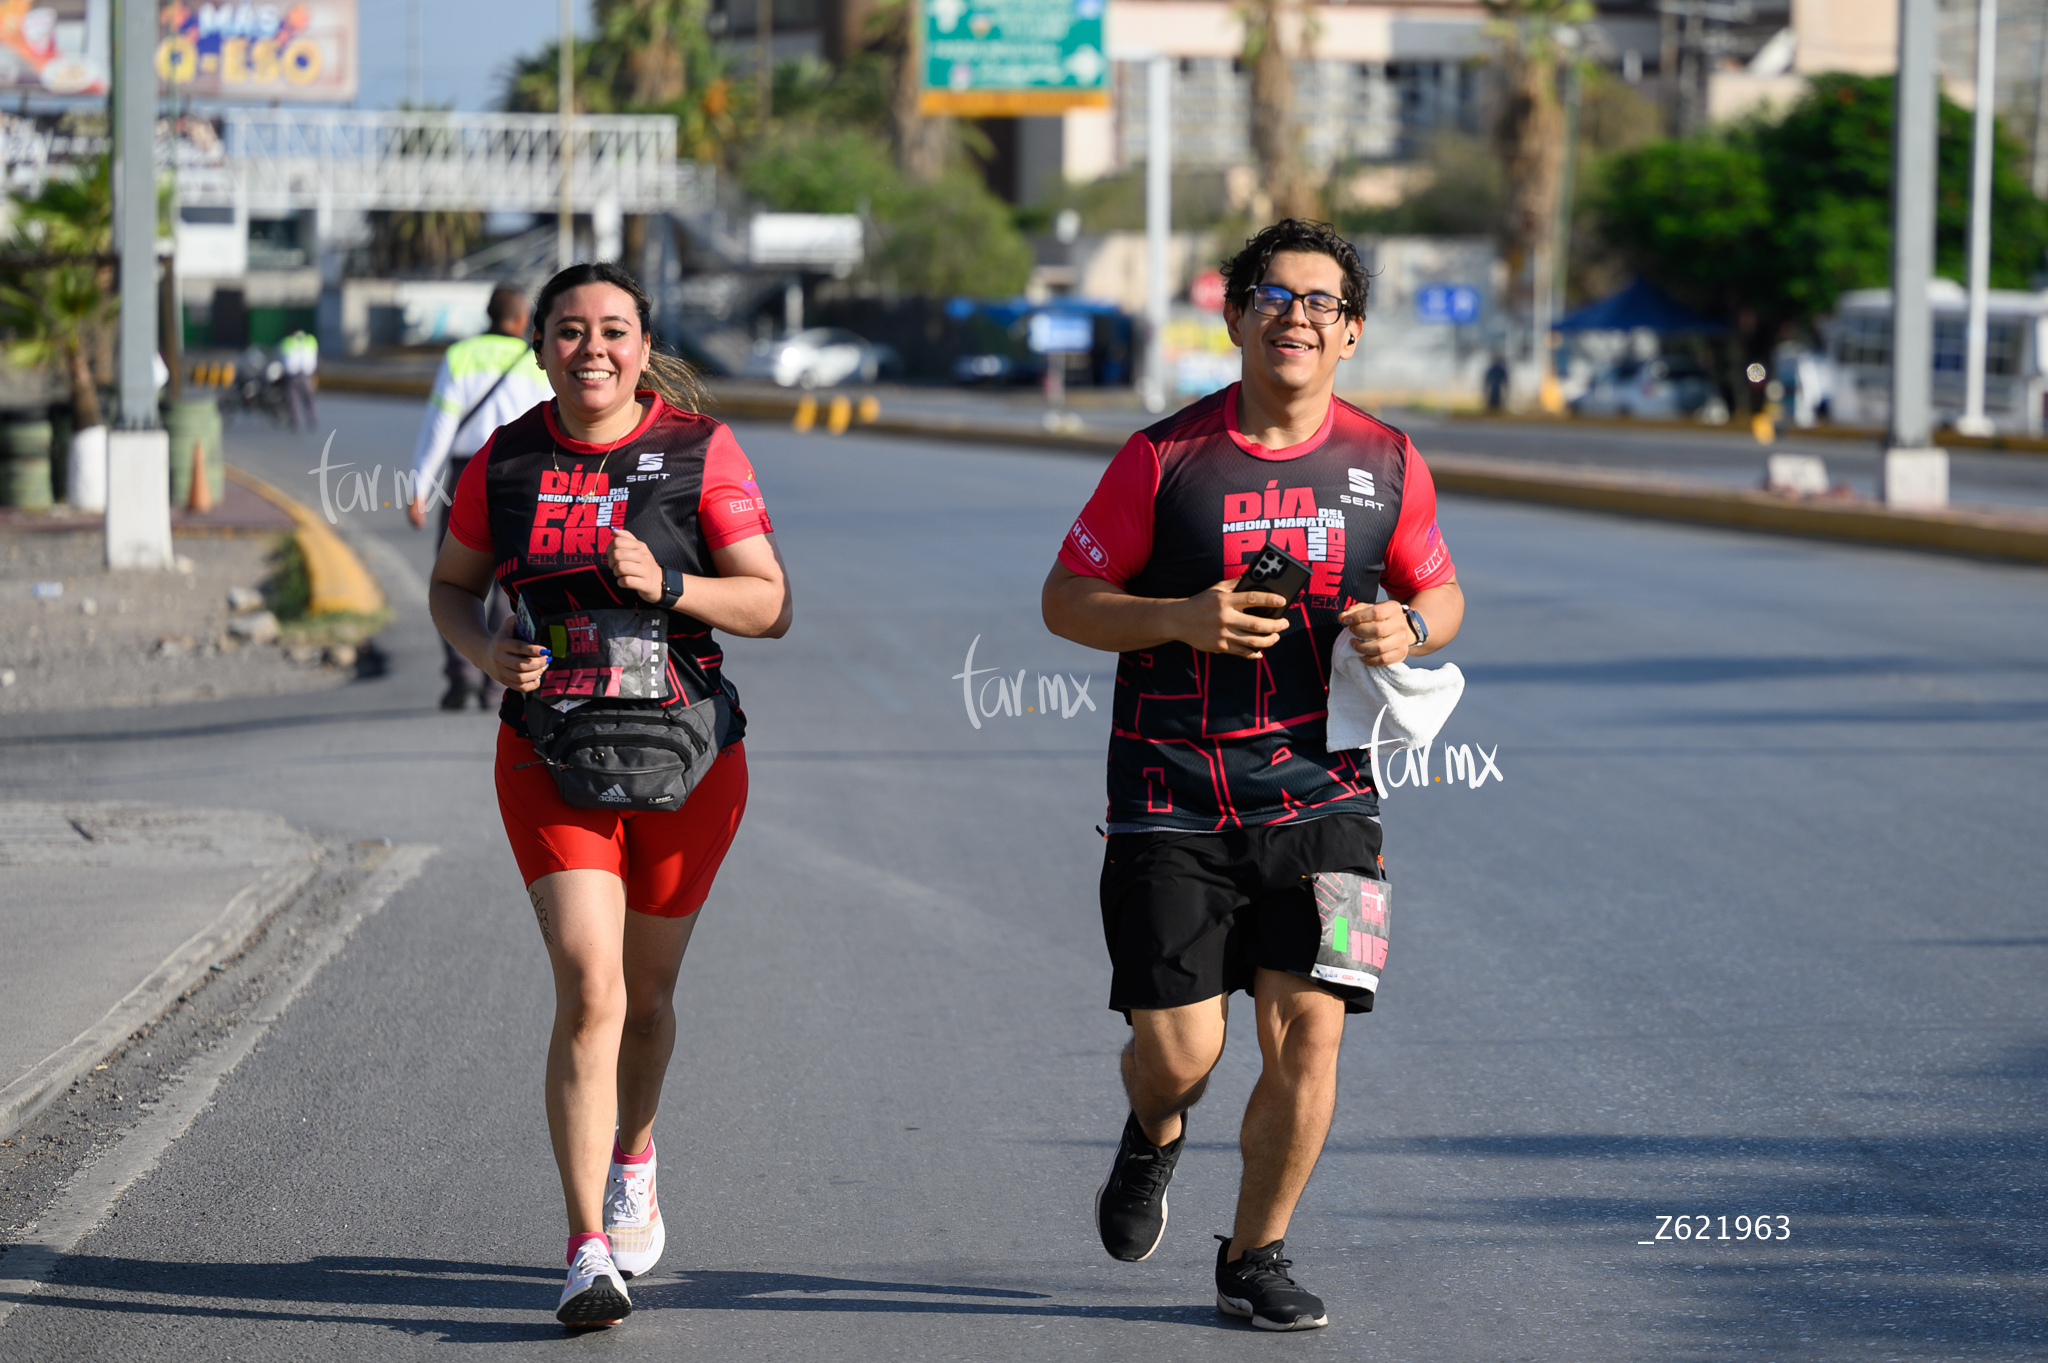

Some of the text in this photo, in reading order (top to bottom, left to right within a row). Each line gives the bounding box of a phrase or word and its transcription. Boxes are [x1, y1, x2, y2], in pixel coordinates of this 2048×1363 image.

[626, 473, 671, 483] SEAT
[537, 494, 574, 503] MEDIA
[1340, 494, 1385, 511] SEAT
[729, 499, 754, 513] 21K
[1222, 519, 1271, 533] MEDIA
[598, 795, 632, 803] adidas
